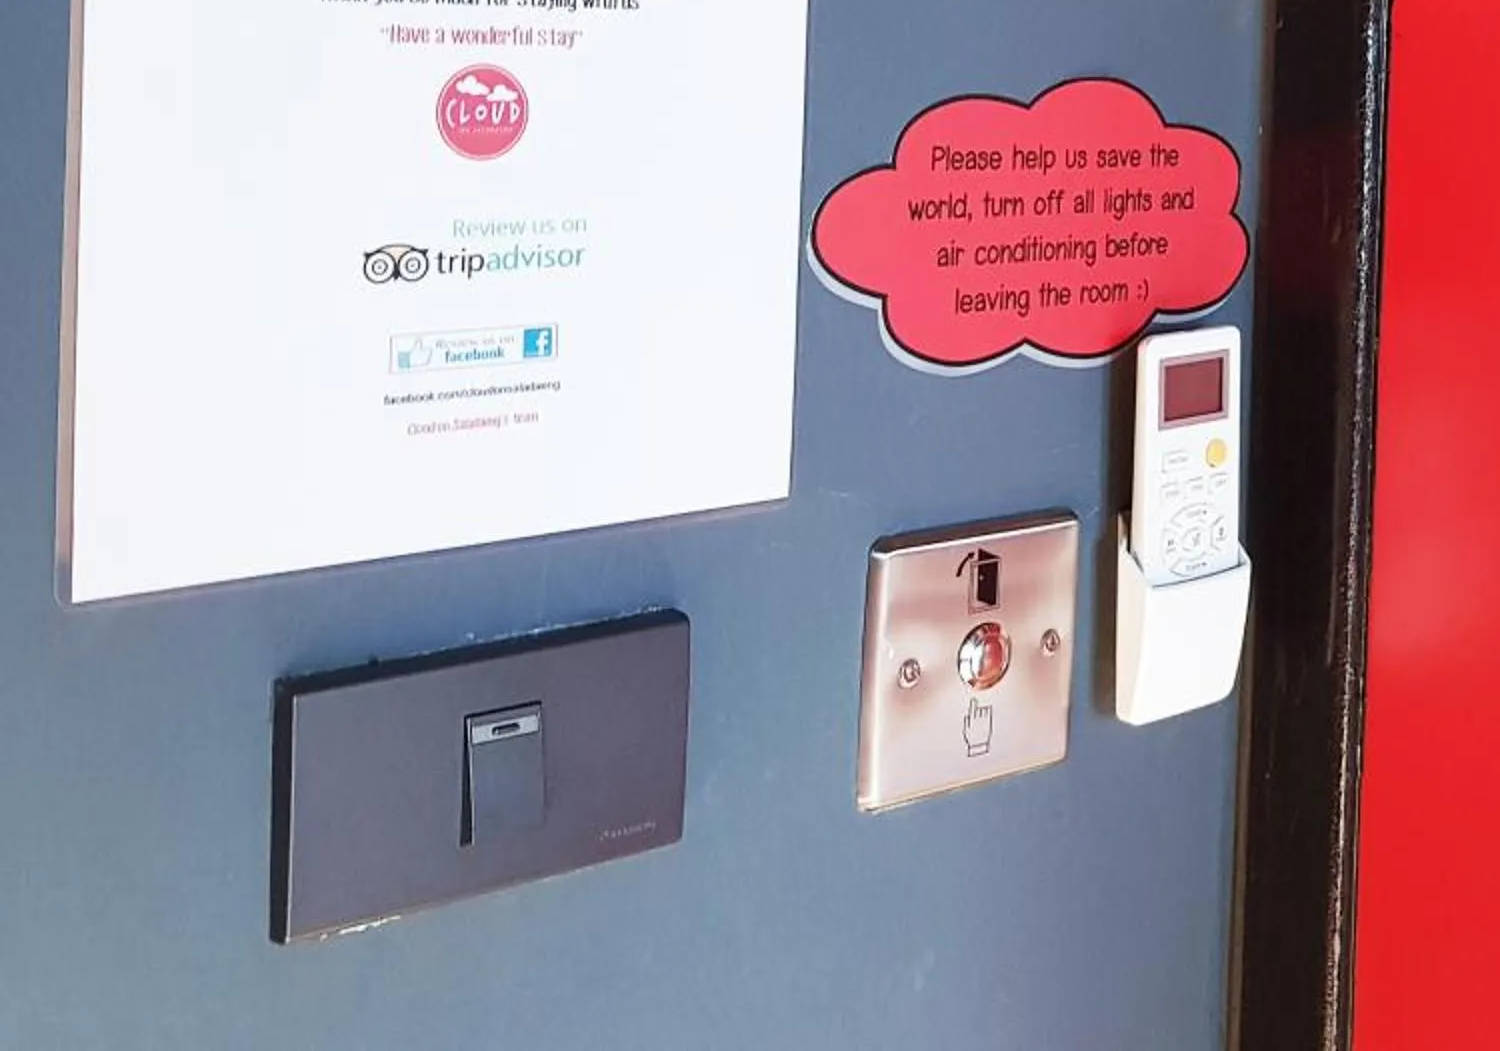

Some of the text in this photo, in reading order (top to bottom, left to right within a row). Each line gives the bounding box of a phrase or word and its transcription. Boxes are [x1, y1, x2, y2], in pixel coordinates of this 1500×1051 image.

[435, 26, 445, 45] a
[452, 24, 533, 47] wonderful
[446, 99, 520, 128] CLOUD
[930, 143, 1180, 176] Please help us save the
[908, 186, 1195, 222] world, turn off all lights and
[453, 216, 587, 238] Review us on
[434, 244, 586, 281] tripadvisor
[937, 231, 1169, 268] air conditioning before
[955, 283, 1031, 317] leaving
[1039, 281, 1072, 307] the
[1079, 282, 1129, 304] room
[445, 346, 505, 364] facebook
